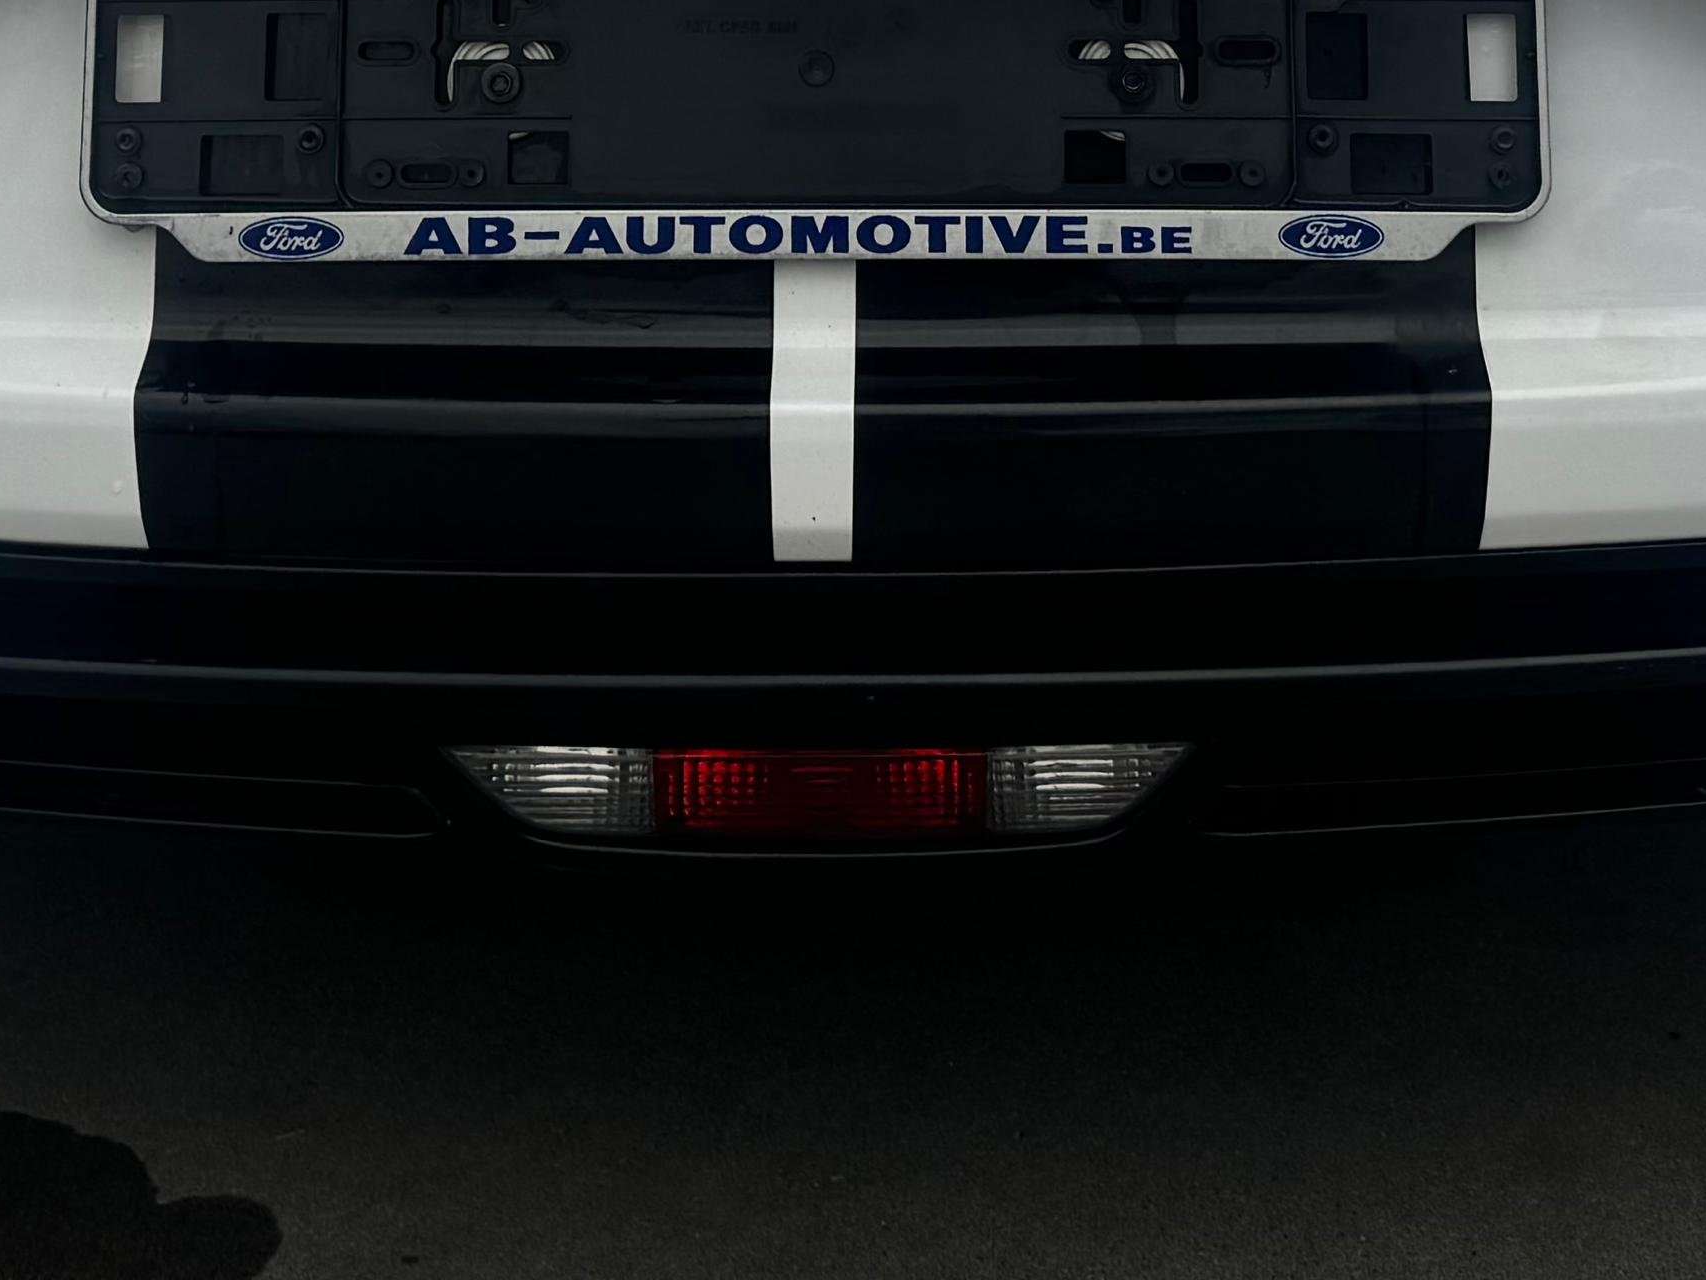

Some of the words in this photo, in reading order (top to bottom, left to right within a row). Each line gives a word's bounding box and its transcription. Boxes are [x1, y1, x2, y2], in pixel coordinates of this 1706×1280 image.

[257, 221, 323, 254] Ford
[403, 215, 1193, 255] AB-AUTOMOTIVE.BE
[1298, 220, 1364, 252] Ford
